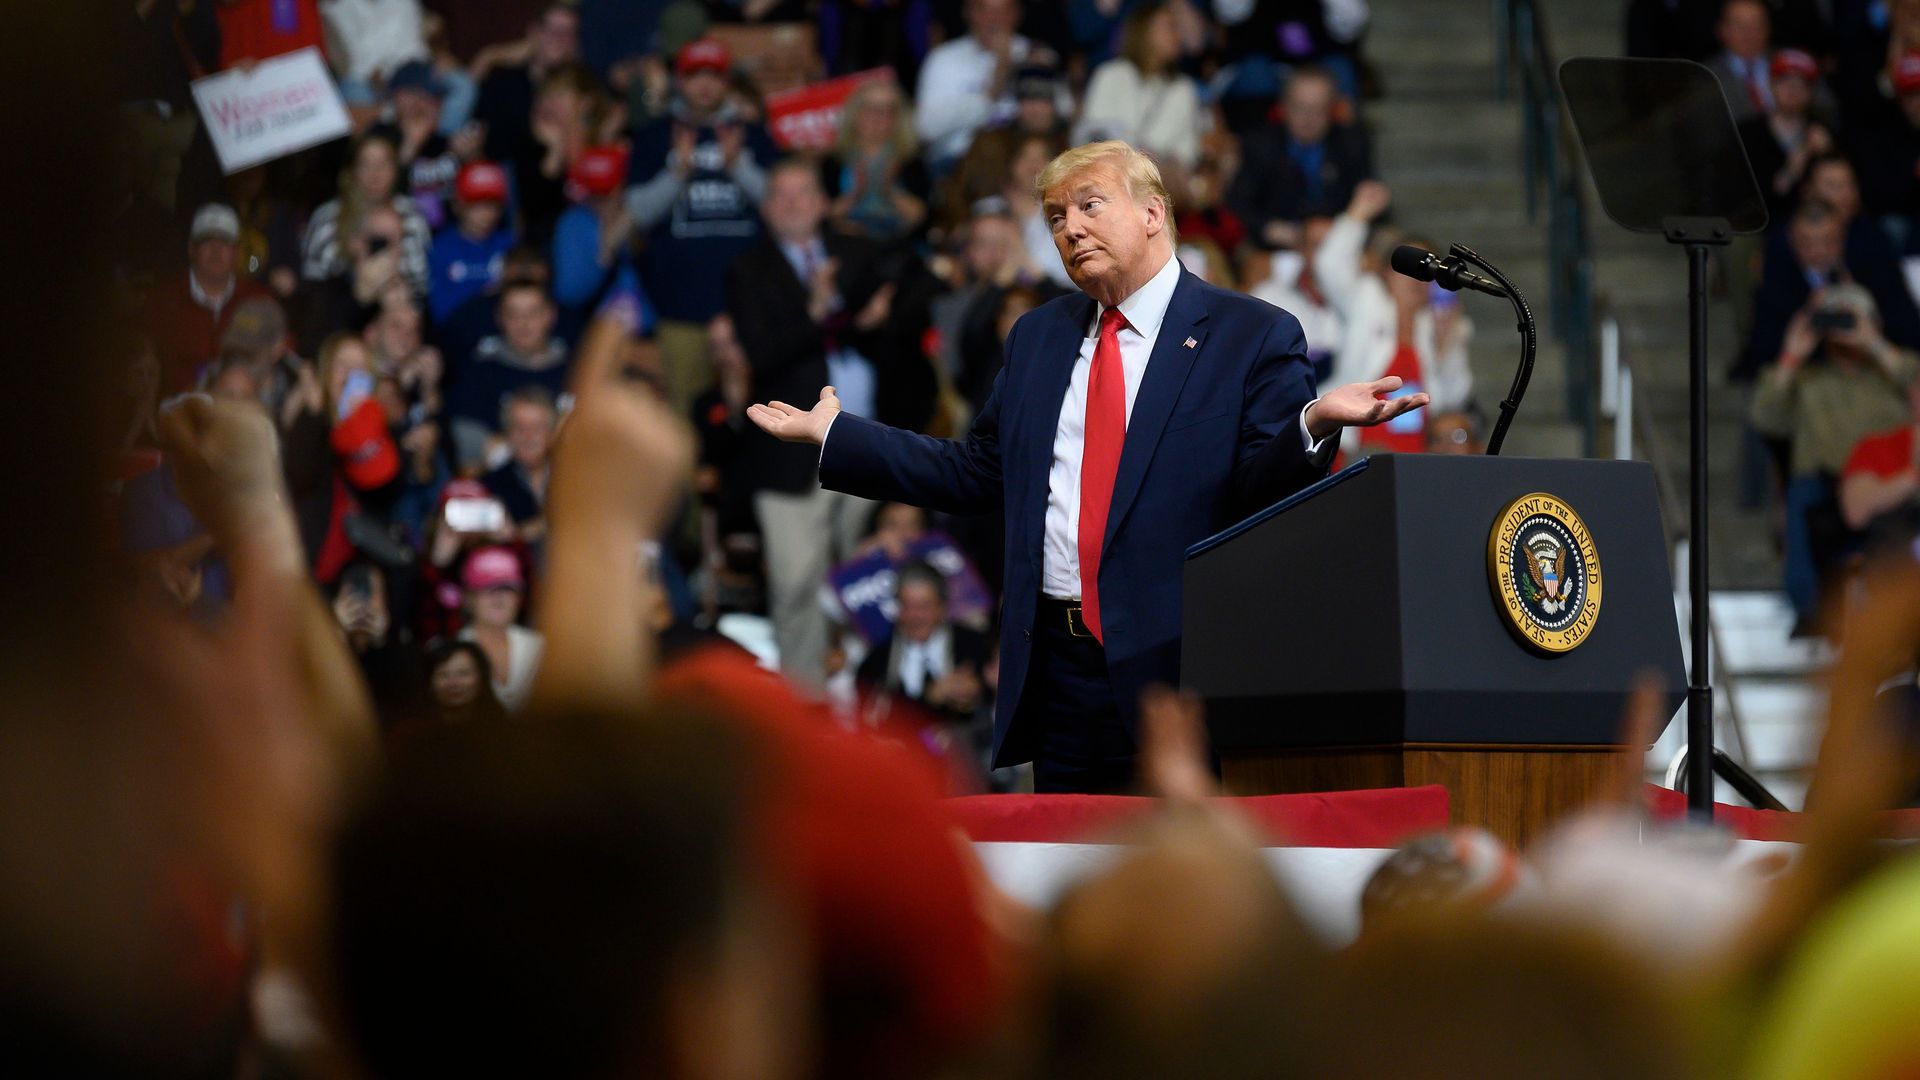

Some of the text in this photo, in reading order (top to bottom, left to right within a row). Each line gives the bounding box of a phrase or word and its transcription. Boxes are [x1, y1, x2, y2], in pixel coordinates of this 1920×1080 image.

[1499, 499, 1598, 645] SEAL OF THE PRESIDENT OF THE UNITED STATES
